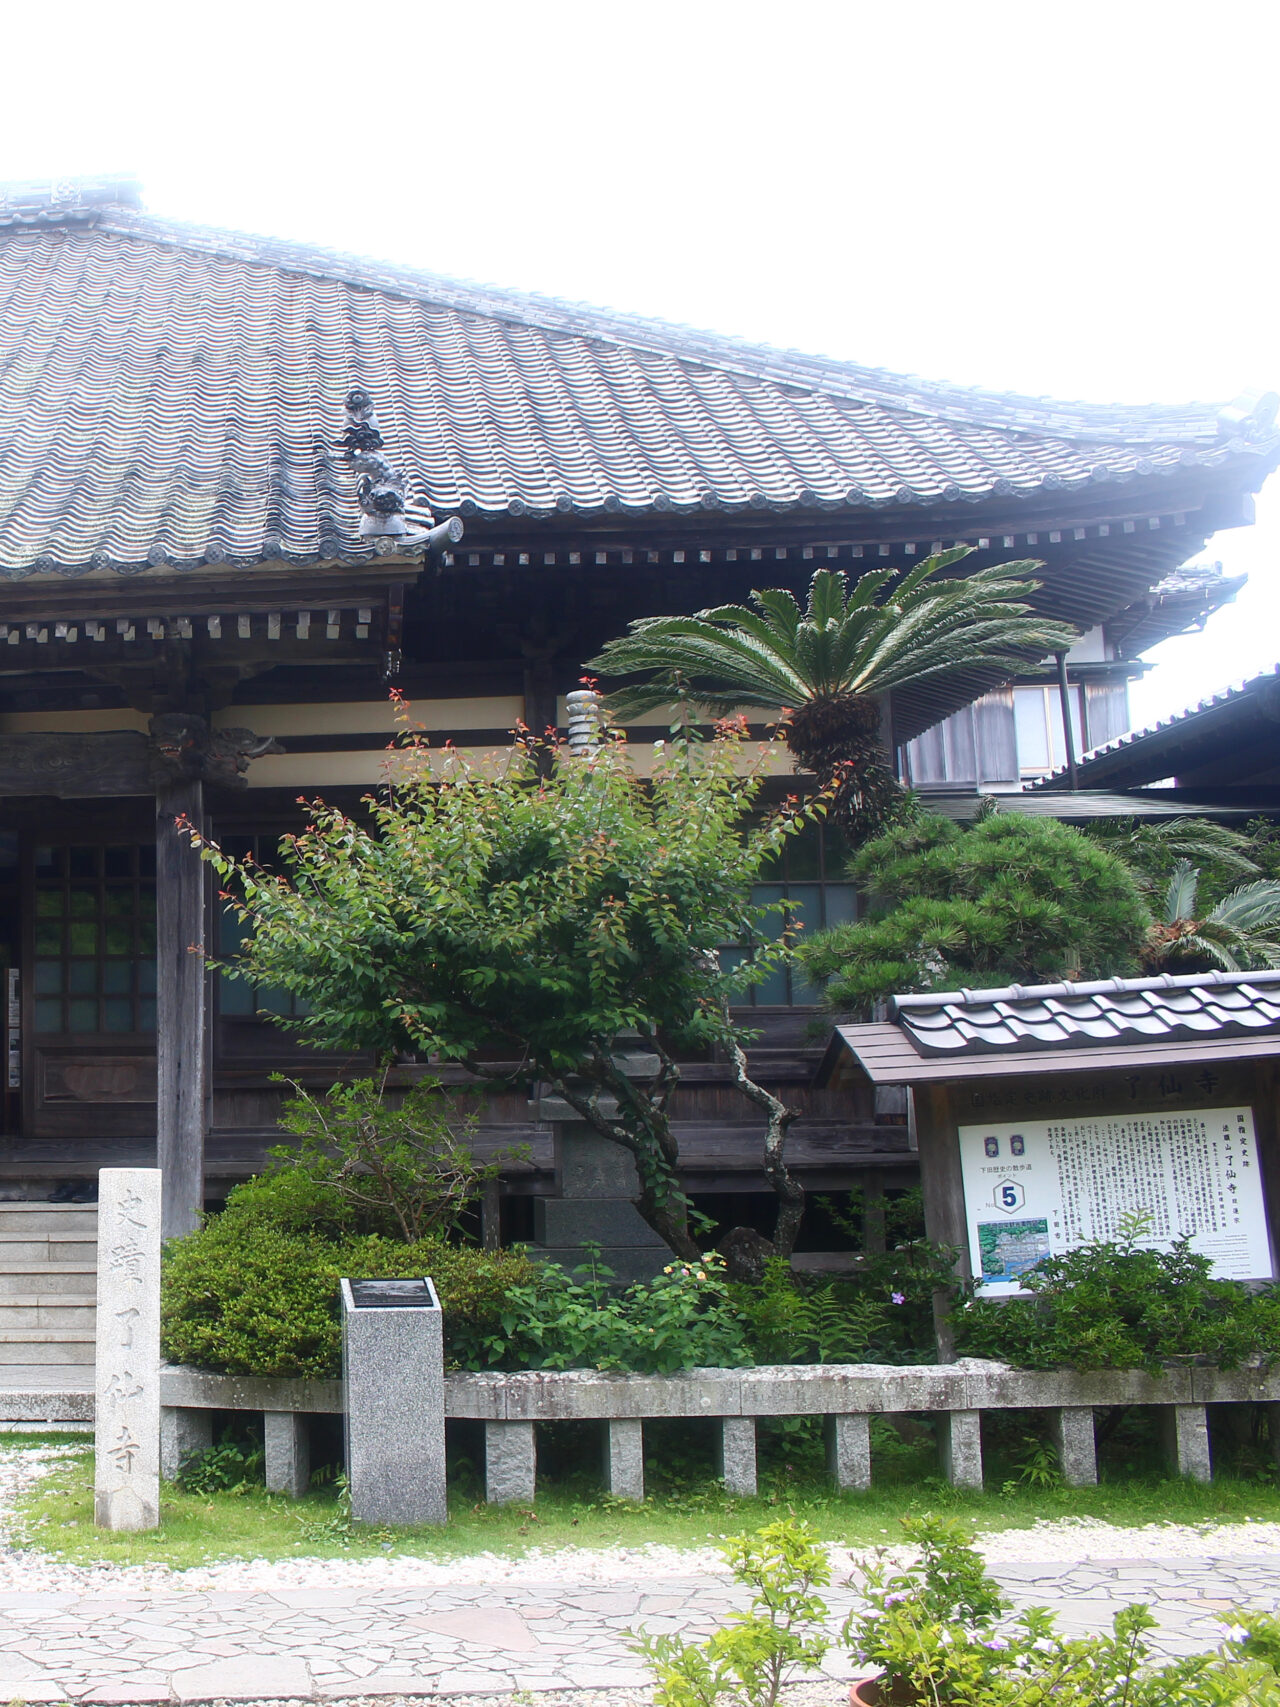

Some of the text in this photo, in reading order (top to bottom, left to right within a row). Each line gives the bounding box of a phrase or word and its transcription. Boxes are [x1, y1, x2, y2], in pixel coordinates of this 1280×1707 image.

[1124, 1069, 1219, 1100] 了仙寺
[980, 1163, 1032, 1174] 下田歴史の散歩道
[1002, 1186, 1017, 1207] 5
